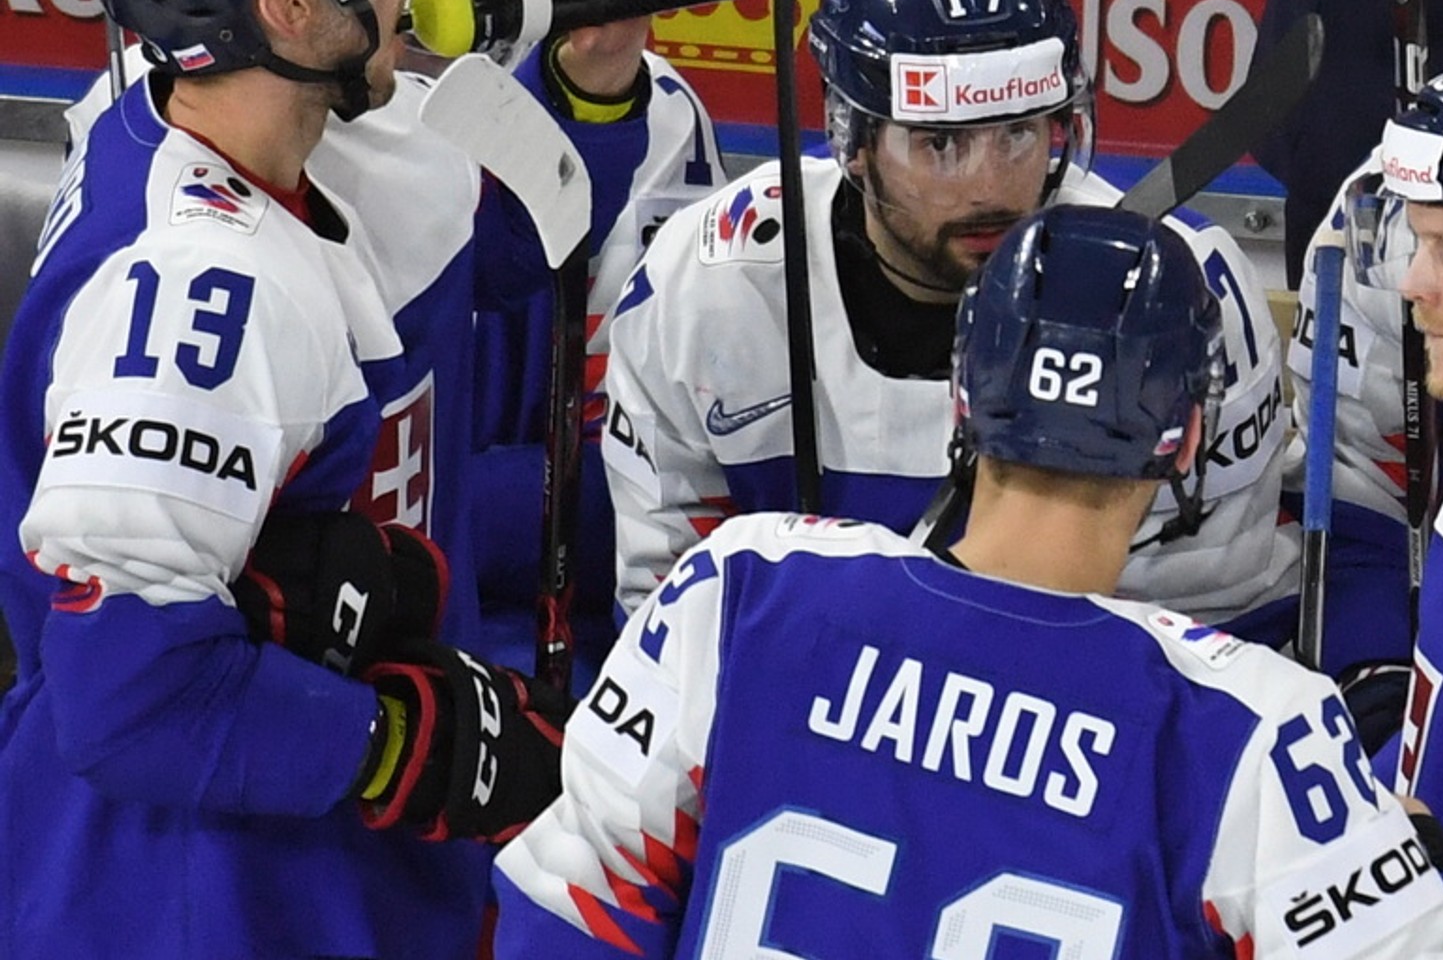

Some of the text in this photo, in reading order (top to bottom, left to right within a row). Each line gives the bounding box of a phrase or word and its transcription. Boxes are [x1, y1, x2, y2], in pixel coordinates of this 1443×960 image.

[955, 66, 1062, 106] Kaufland
[113, 259, 257, 392] 13
[1028, 347, 1103, 407] 62
[52, 409, 259, 492] ŠKODA
[808, 643, 1116, 817] JAROS
[1269, 692, 1381, 846] 62
